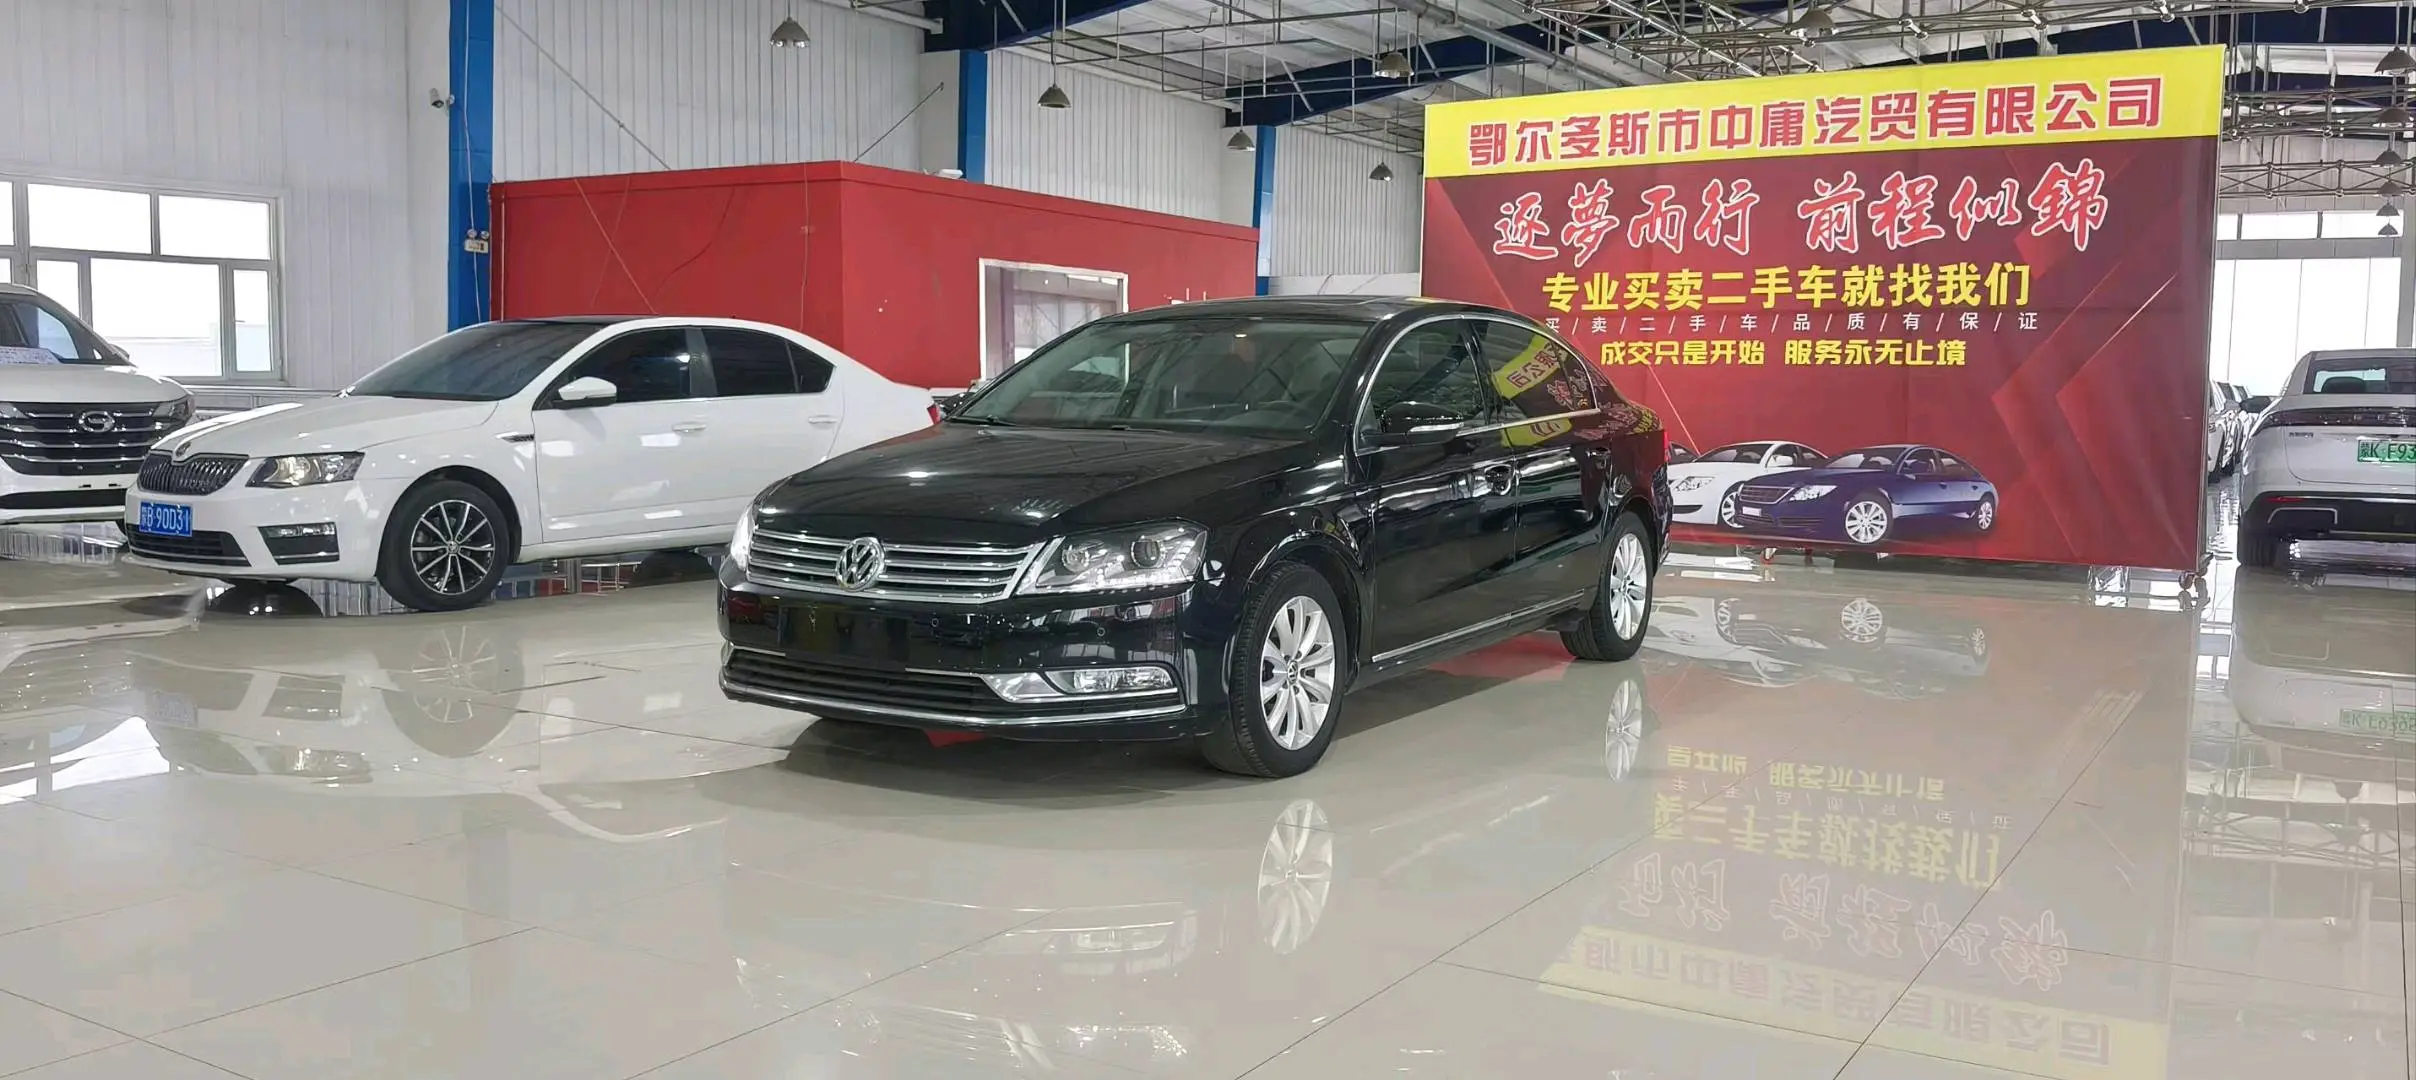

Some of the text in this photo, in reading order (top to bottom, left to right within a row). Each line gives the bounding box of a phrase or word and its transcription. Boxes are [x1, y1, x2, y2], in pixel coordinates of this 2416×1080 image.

[1467, 76, 2163, 167] 鄂尔多斯市中庸汽贸有限公司
[1542, 261, 2030, 313] 专业买卖二手车就找我们
[1601, 339, 1967, 366] 成交只是开始 服务永无止境
